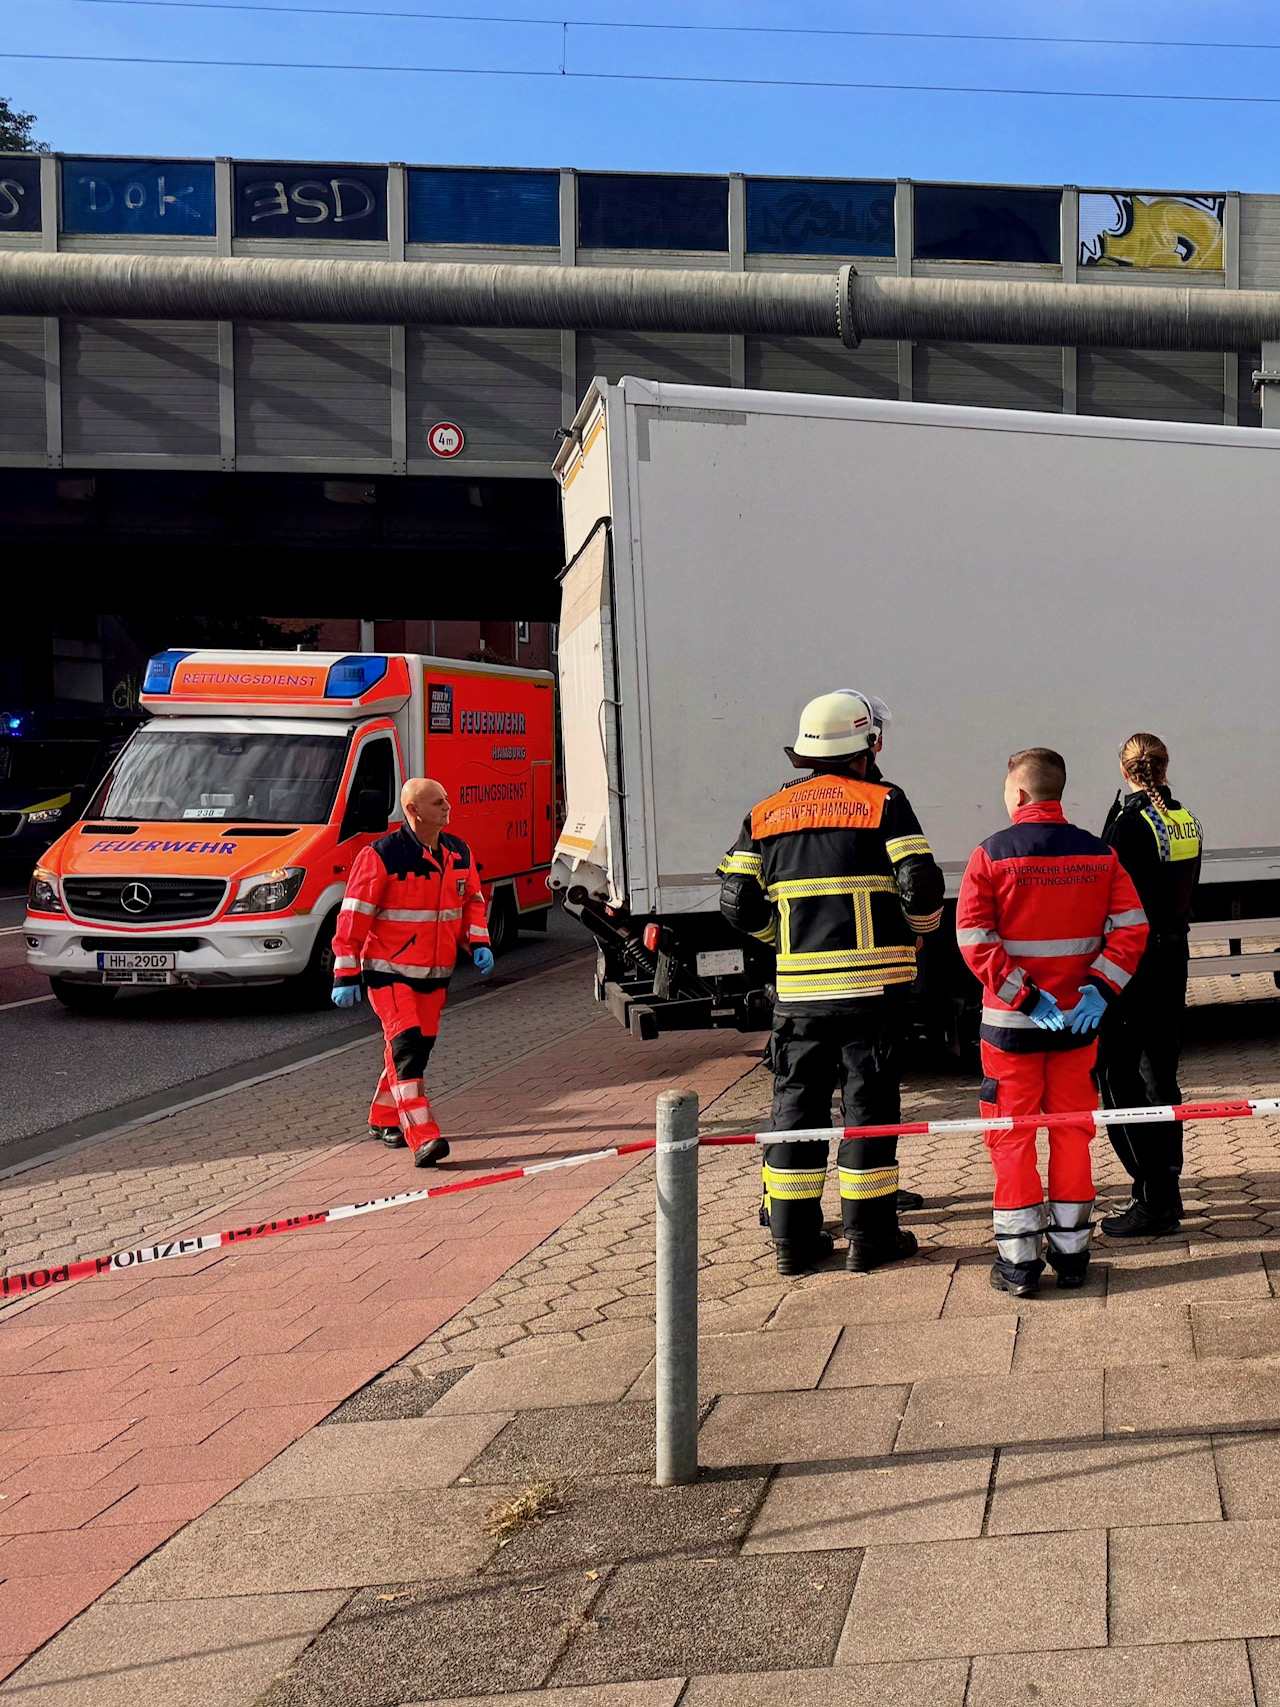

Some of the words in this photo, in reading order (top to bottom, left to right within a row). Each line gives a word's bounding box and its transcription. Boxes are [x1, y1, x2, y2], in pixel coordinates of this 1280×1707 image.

[438, 432, 446, 446] 4
[182, 672, 317, 687] RETTUNGSDIENST
[460, 710, 526, 735] FEUERWEHR
[491, 746, 526, 760] HAMBURG
[459, 781, 528, 804] RETTUNGSDIENST
[821, 801, 869, 819] HAMBURG
[515, 820, 528, 839] 112
[88, 840, 238, 855] FEUERWEHR
[1002, 865, 1060, 875] FEUERWEHR
[1063, 863, 1109, 874] HAMBURG
[1017, 875, 1097, 886] RETTUNGSDIENST
[109, 956, 127, 968] HH
[134, 955, 168, 968] 2909
